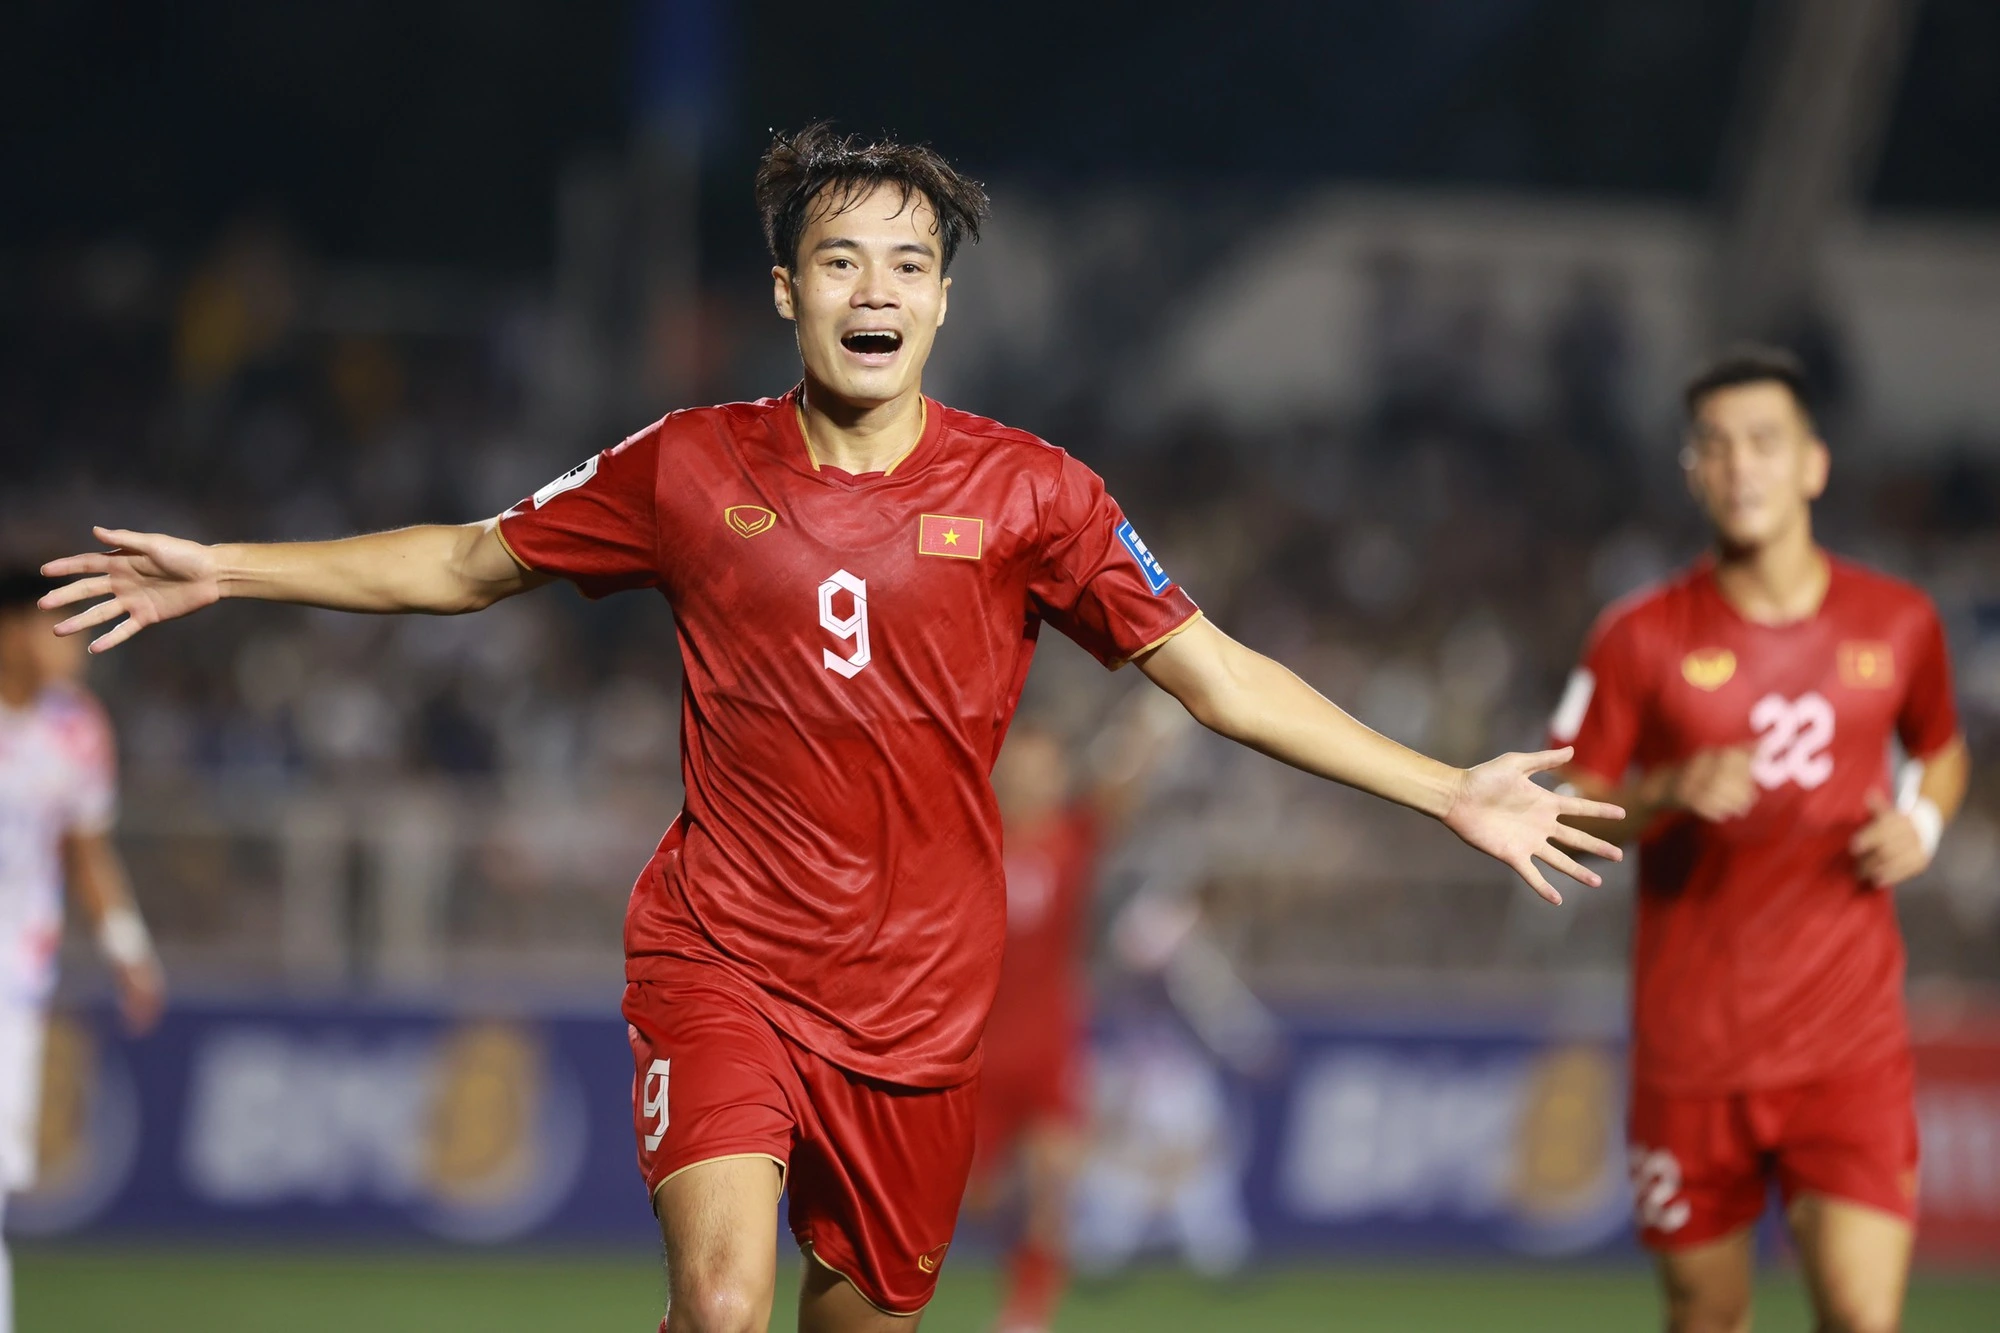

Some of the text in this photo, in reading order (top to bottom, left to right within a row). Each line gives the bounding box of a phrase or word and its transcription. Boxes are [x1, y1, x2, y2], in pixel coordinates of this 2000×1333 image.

[818, 569, 871, 679] 9
[1750, 692, 1835, 789] 22
[643, 1058, 671, 1151] 9
